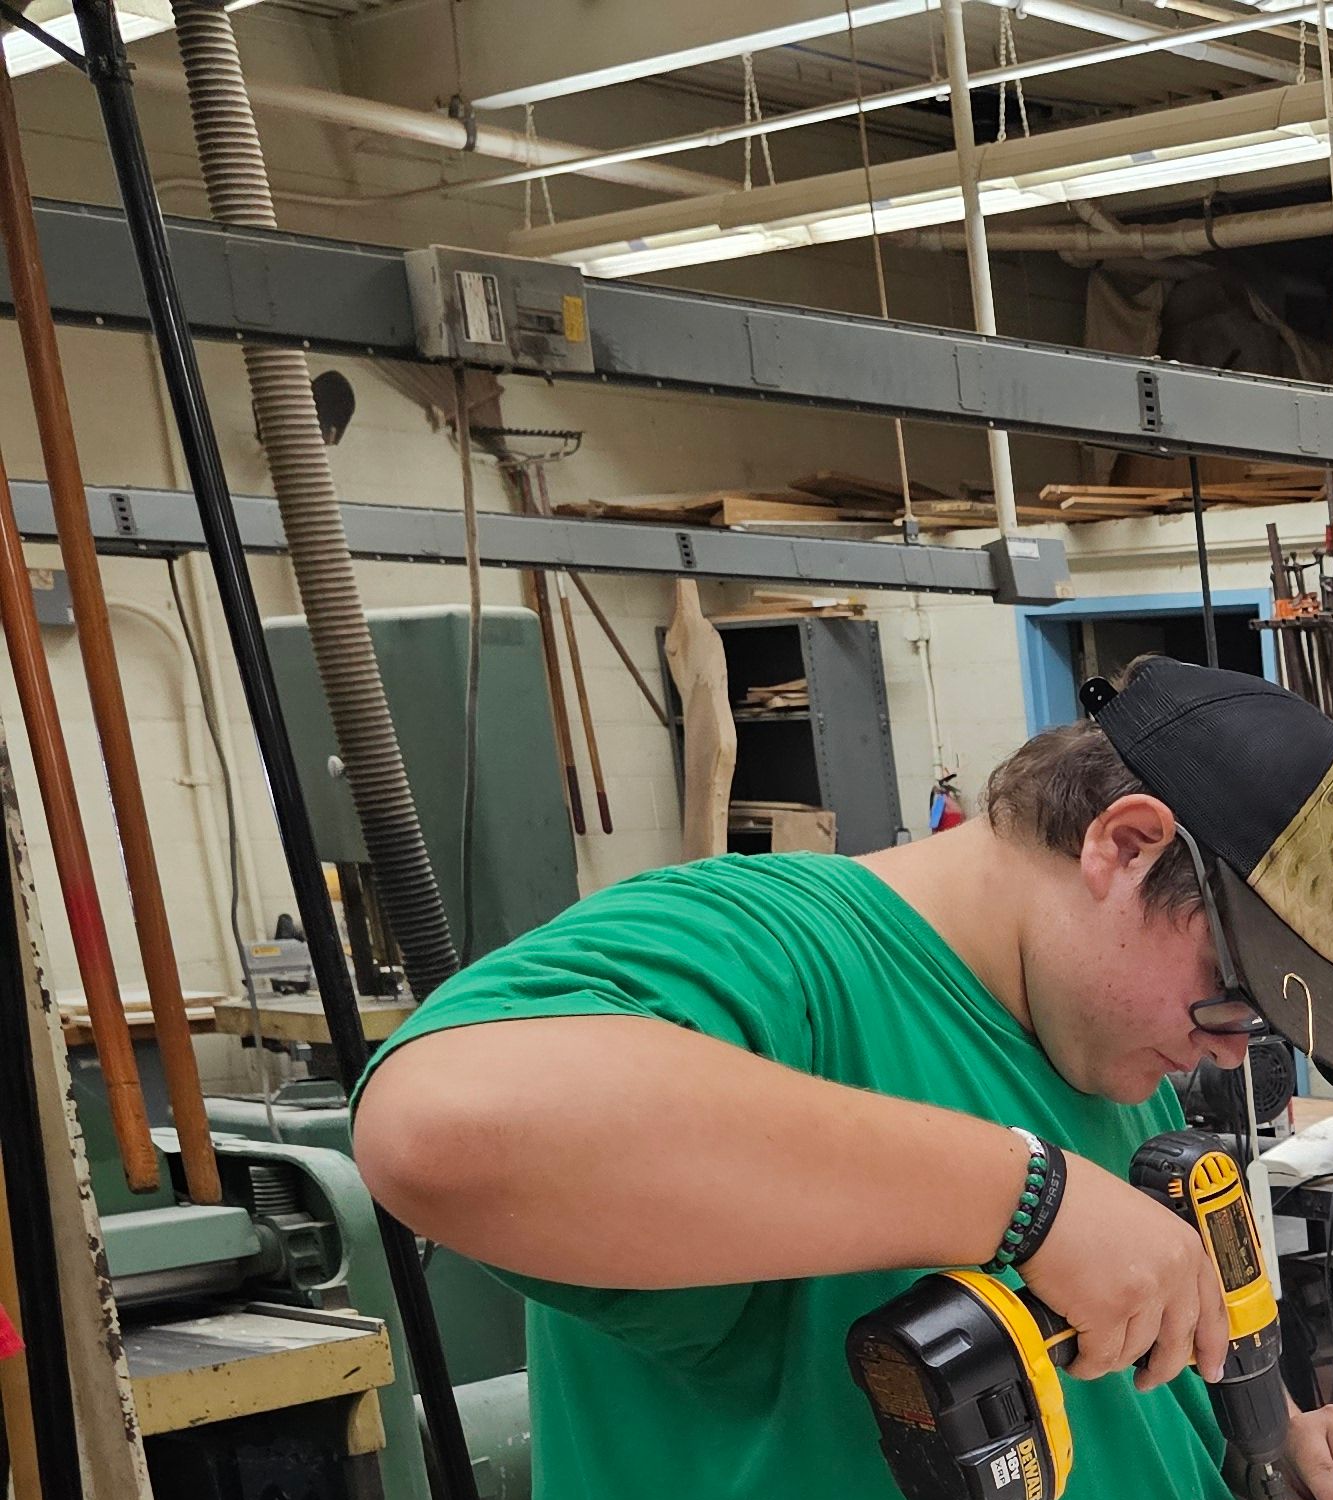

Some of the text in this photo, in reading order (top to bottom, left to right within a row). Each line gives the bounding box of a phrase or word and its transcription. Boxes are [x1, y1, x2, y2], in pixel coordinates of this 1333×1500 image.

[1028, 1206, 1050, 1236] THE
[1045, 1168, 1061, 1206] PAST
[995, 1460, 1007, 1484] XRP
